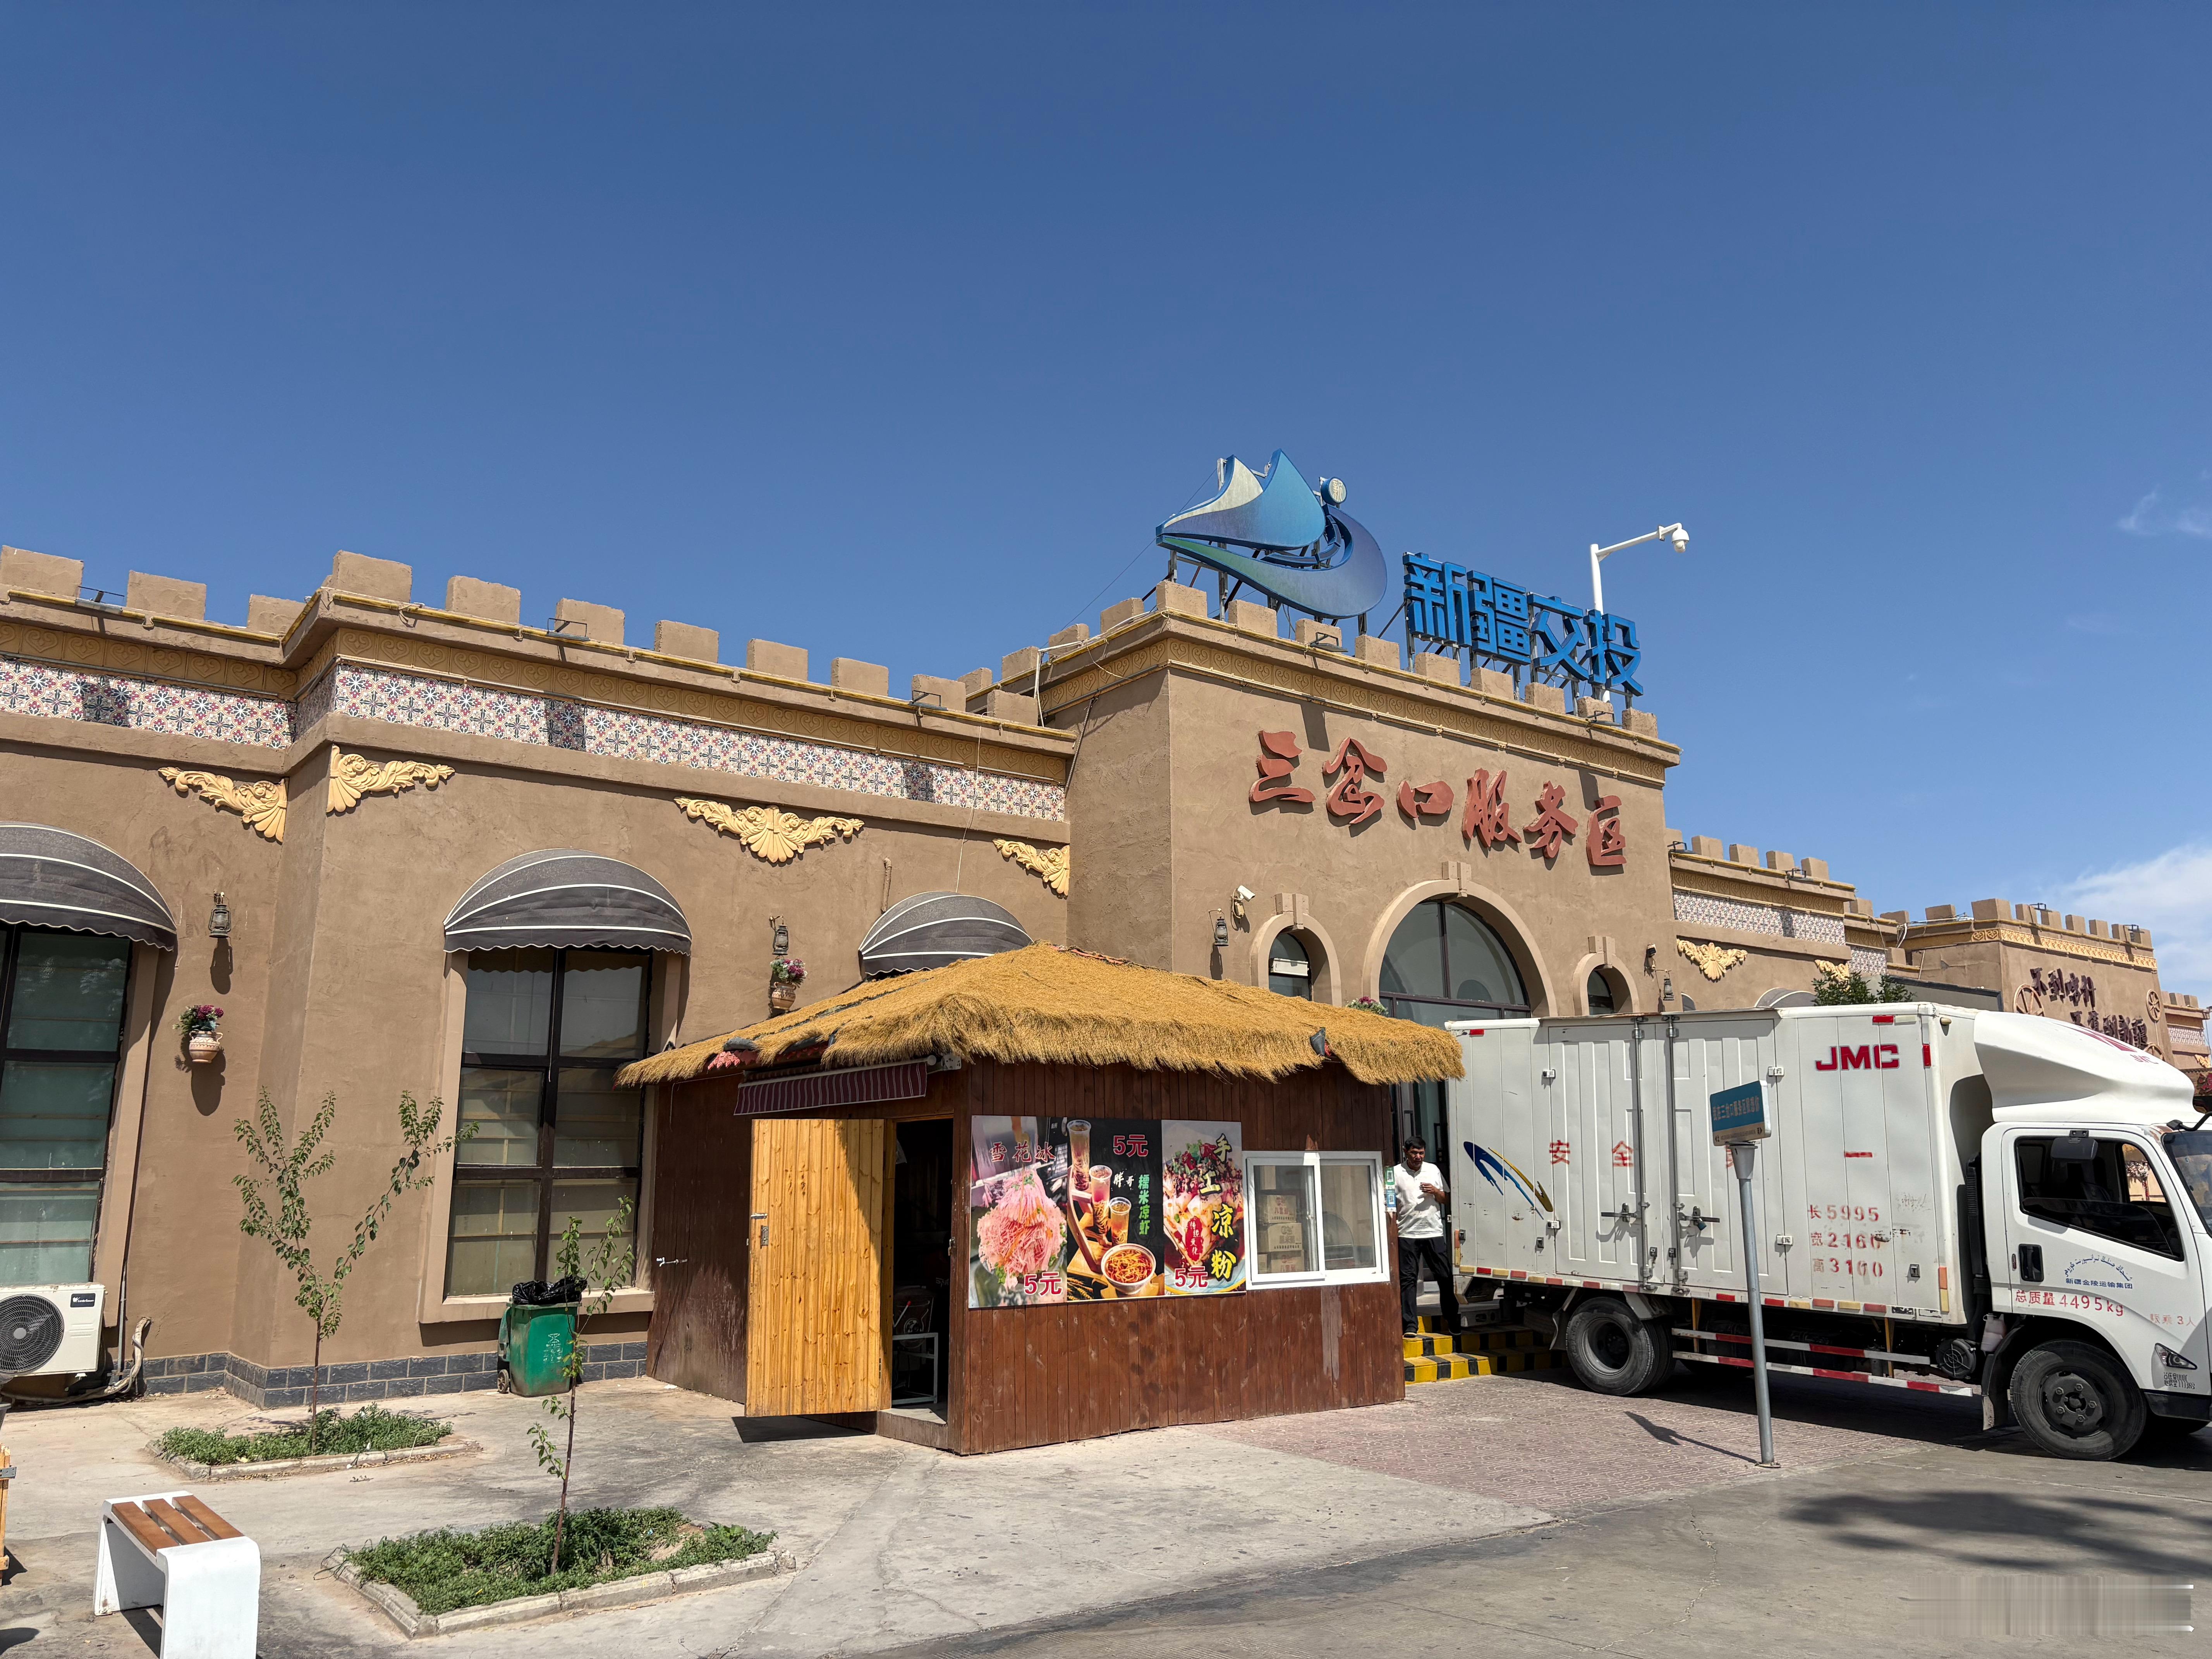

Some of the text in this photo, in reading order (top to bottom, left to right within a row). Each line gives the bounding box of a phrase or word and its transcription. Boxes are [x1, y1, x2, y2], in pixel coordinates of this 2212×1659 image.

[1403, 552, 1643, 696] 新疆交投
[1249, 730, 1626, 866] 三岔口服务区
[1815, 1044, 1900, 1071] JMC
[989, 1140, 1056, 1162] 雪花冰
[1113, 1135, 1149, 1157] 5元
[1113, 1171, 1134, 1187] 胖哥
[1138, 1174, 1150, 1235] 糯米凉虾
[1200, 1133, 1237, 1281] 手工凉粉
[1190, 1221, 1199, 1255] 传统文化
[1024, 1271, 1062, 1296] 5元
[1175, 1266, 1208, 1288] 5元
[2066, 1278, 2133, 1289] 新疆金陵运输集团
